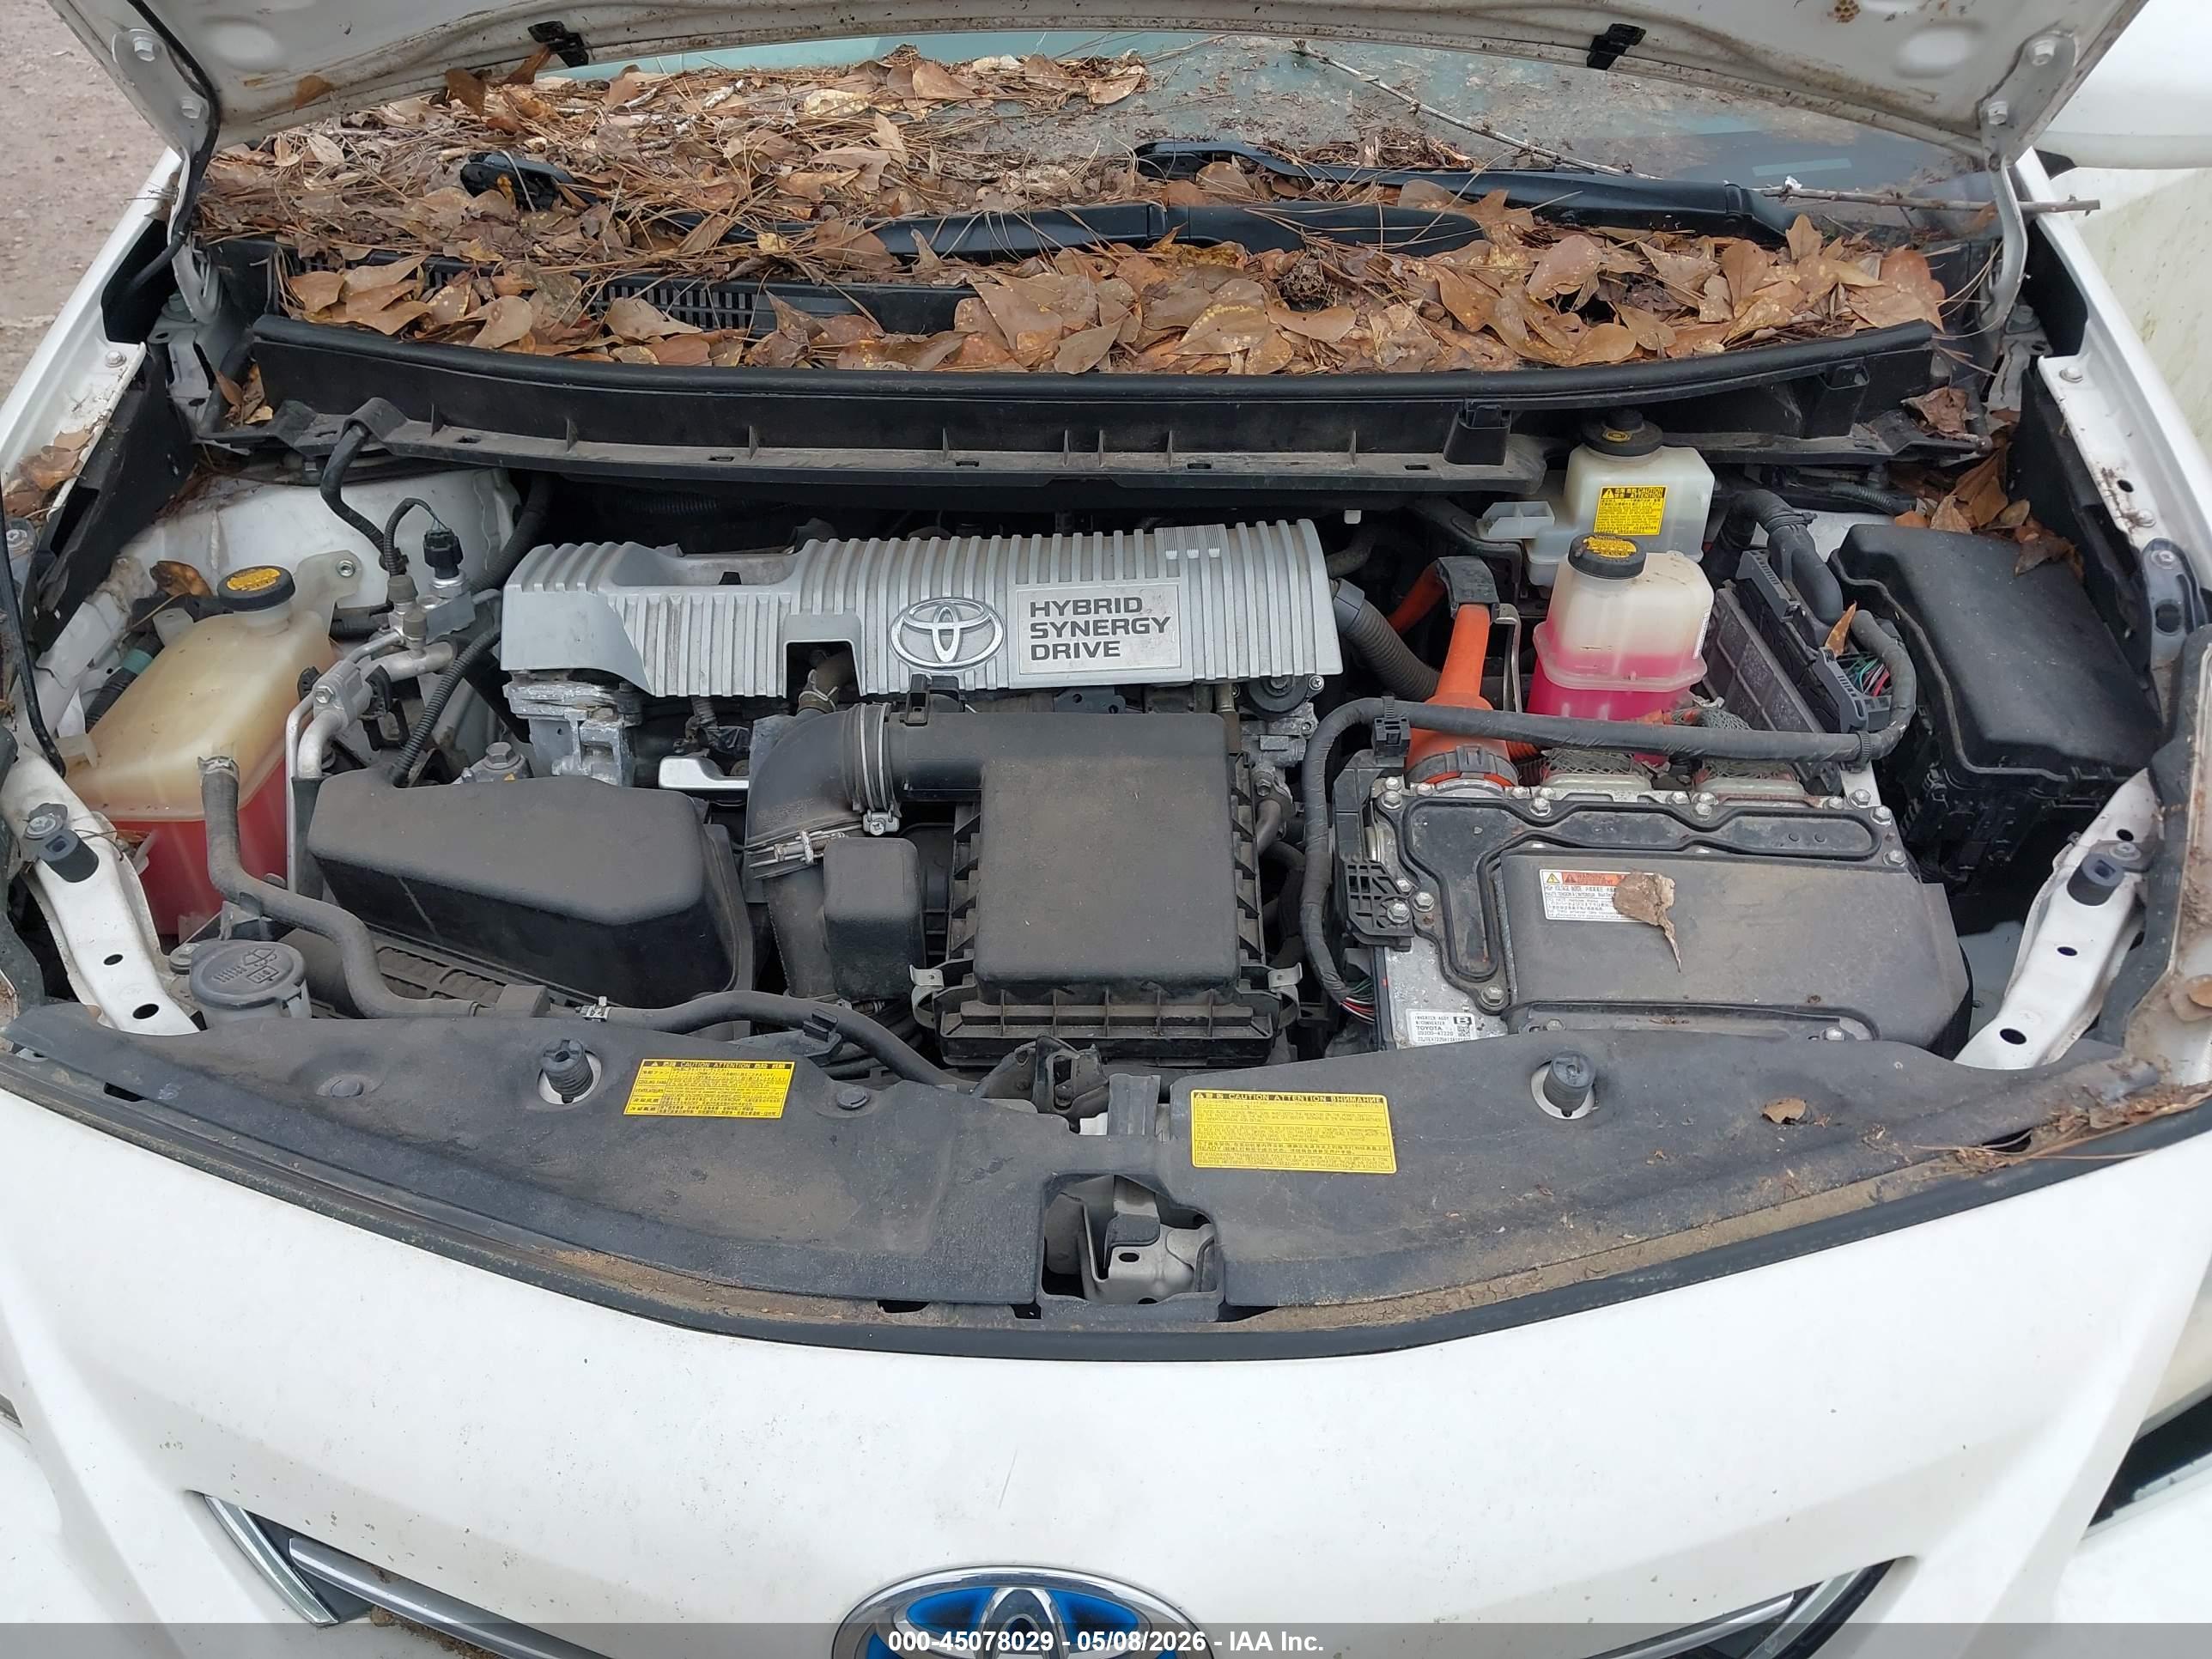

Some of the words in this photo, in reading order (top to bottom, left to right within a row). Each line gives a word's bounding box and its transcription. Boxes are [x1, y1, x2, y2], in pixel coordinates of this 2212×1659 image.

[1030, 596, 1142, 618] HYBRID
[1030, 616, 1171, 640] SYNERGY
[1030, 640, 1121, 662] DRIVE
